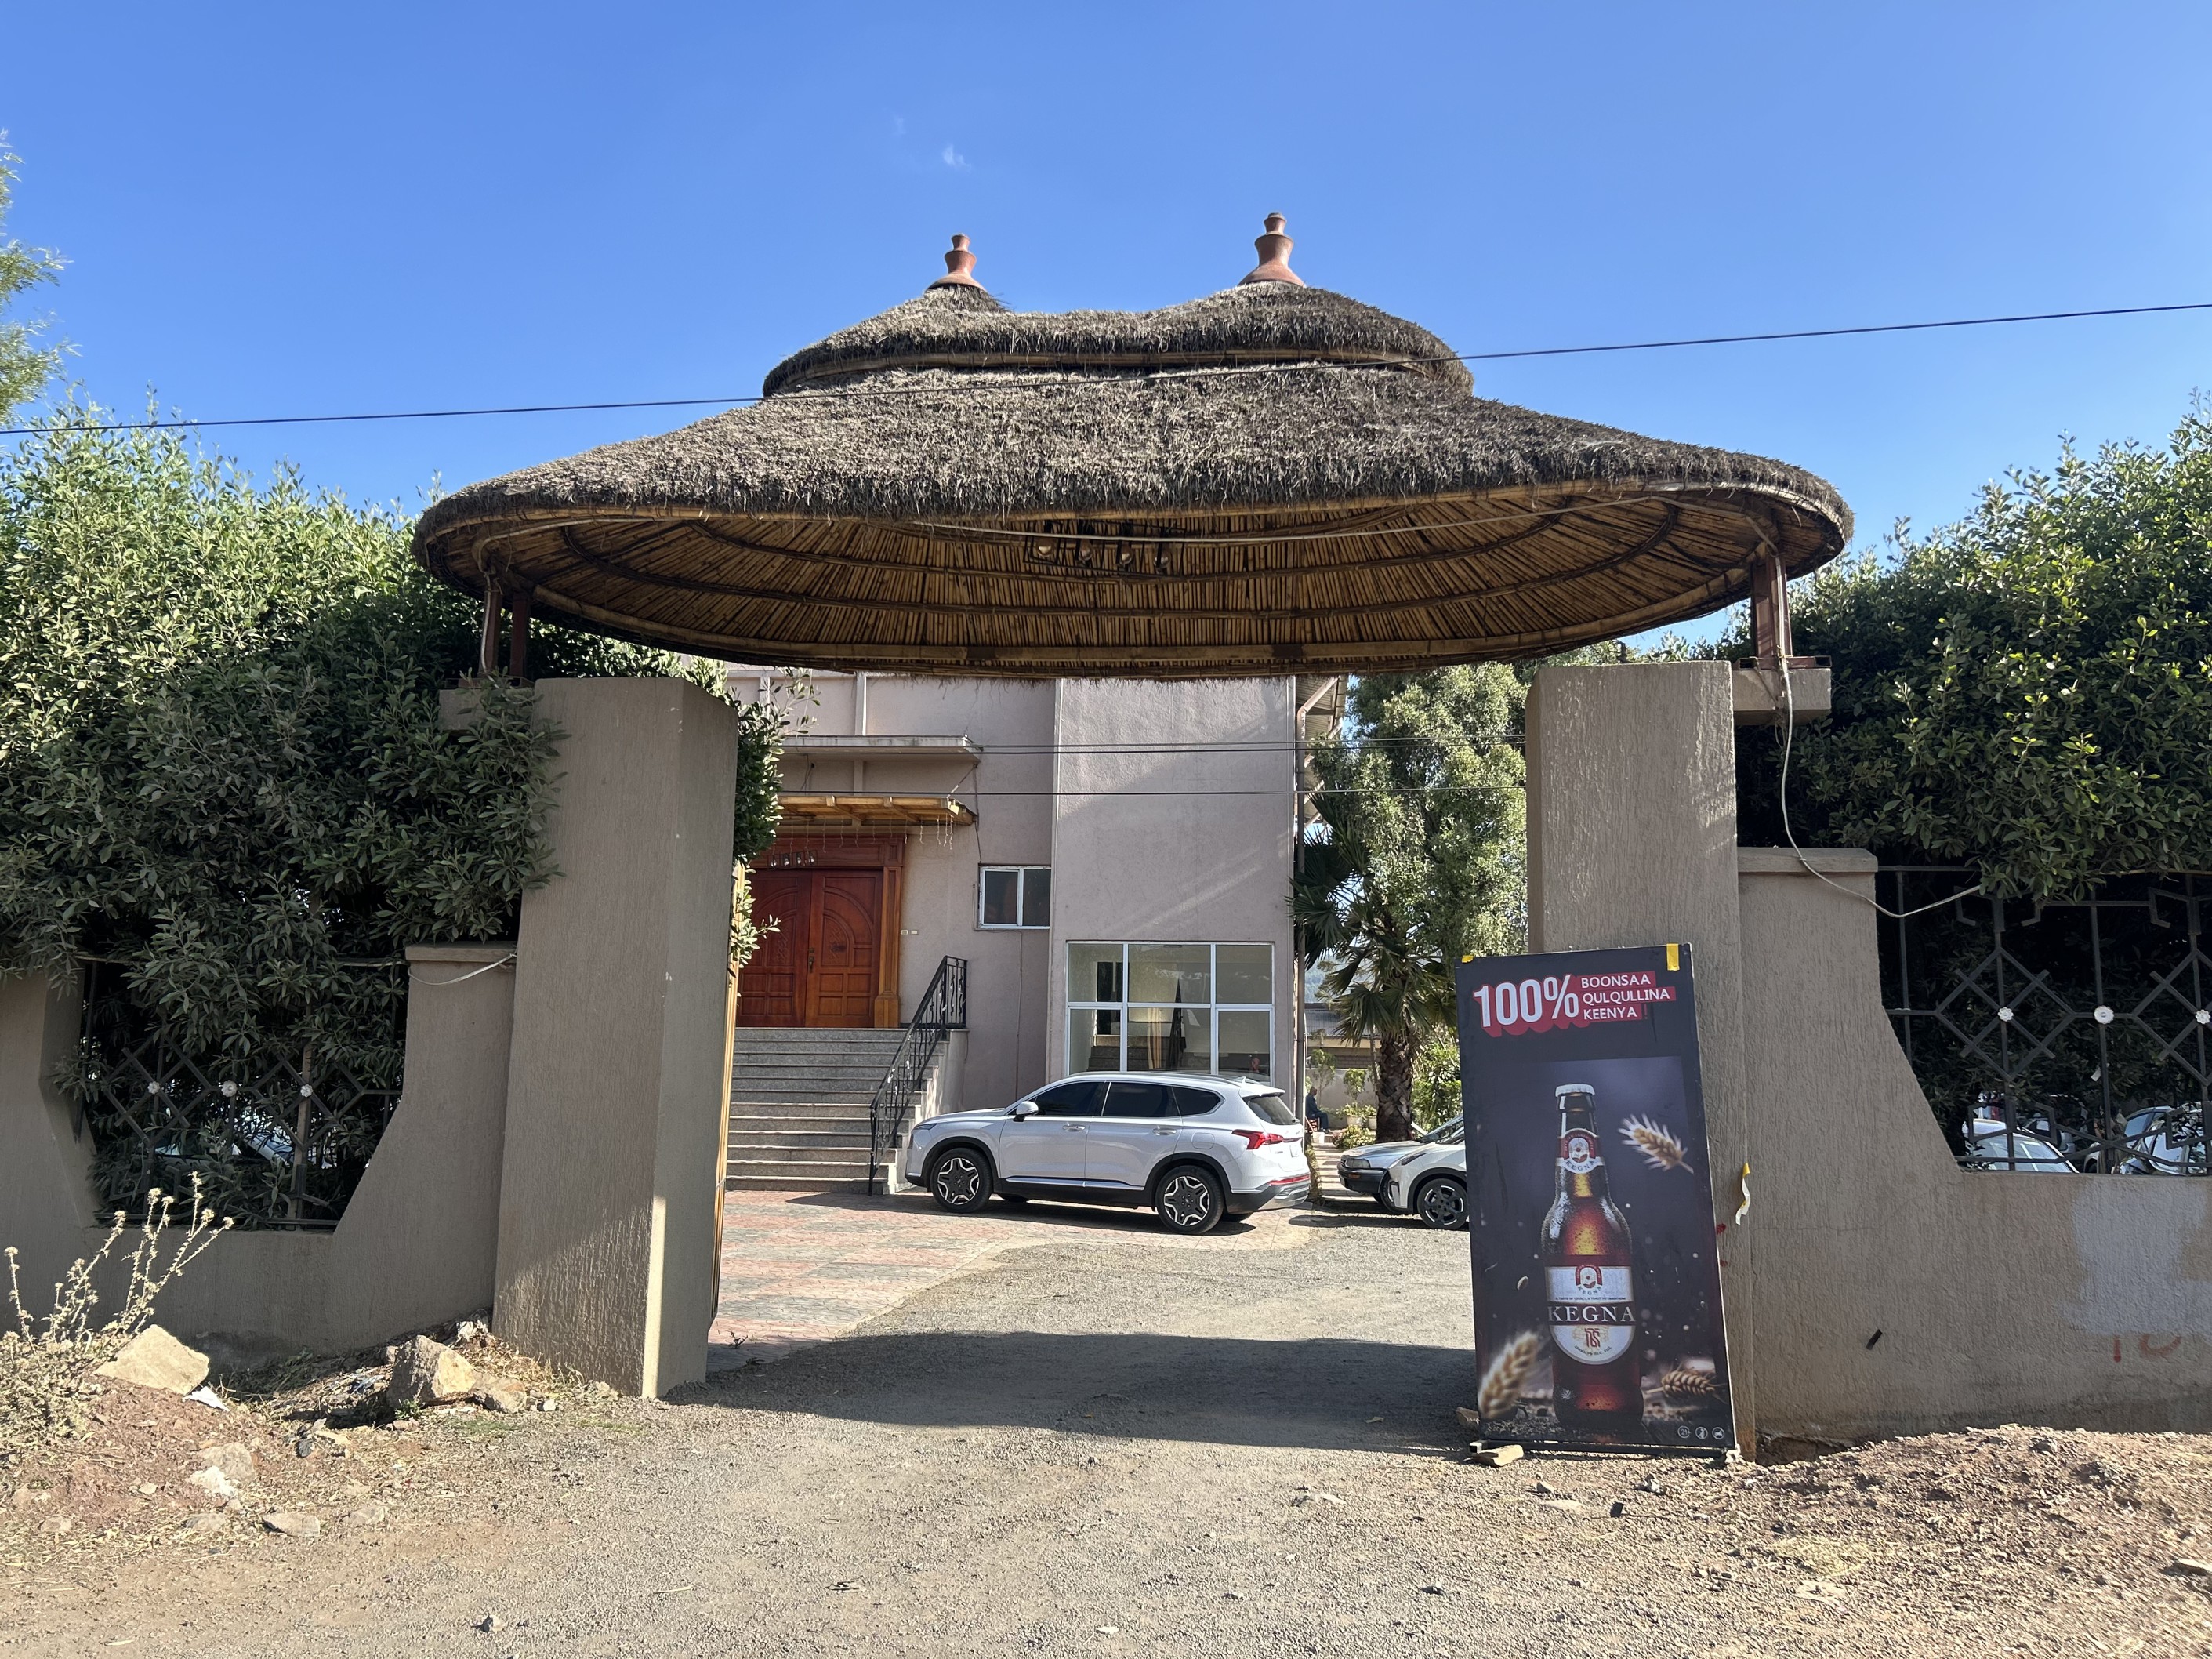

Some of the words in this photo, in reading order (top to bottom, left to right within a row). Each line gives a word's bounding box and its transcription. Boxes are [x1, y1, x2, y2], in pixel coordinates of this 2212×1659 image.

[1581, 974, 1651, 989] BOONSAA
[1474, 975, 1579, 1028] 100%
[1583, 989, 1670, 1006] QULQULLINA
[1547, 1305, 1636, 1322] KEGNA
